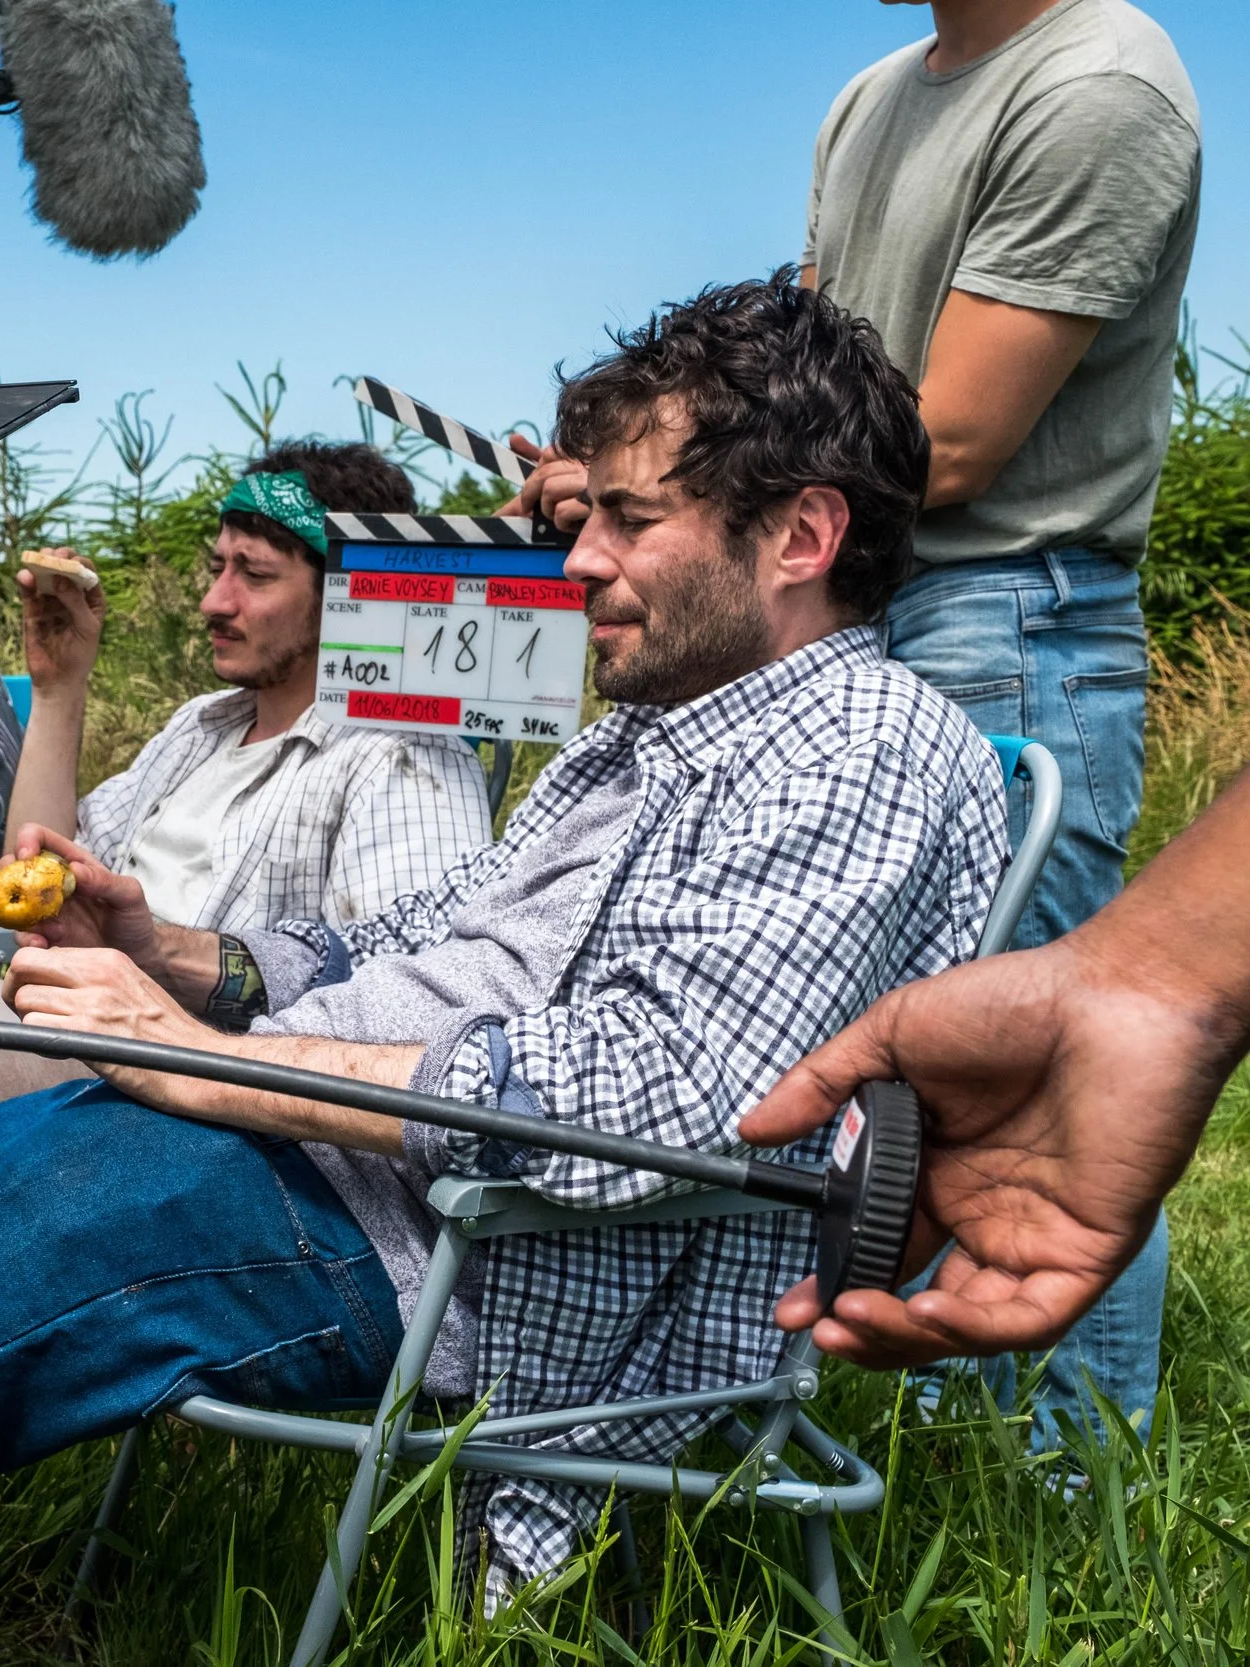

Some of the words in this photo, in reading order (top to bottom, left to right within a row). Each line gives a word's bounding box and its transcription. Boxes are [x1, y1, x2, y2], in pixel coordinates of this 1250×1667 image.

[383, 549, 474, 569] HARVEST
[328, 576, 348, 587] DIR
[457, 582, 486, 593] CAM
[326, 602, 362, 613] SCENE
[411, 606, 448, 618] SLATE
[501, 610, 534, 622] TAKE
[423, 620, 479, 674] 18
[516, 627, 542, 679] 1
[319, 692, 347, 703] DATE
